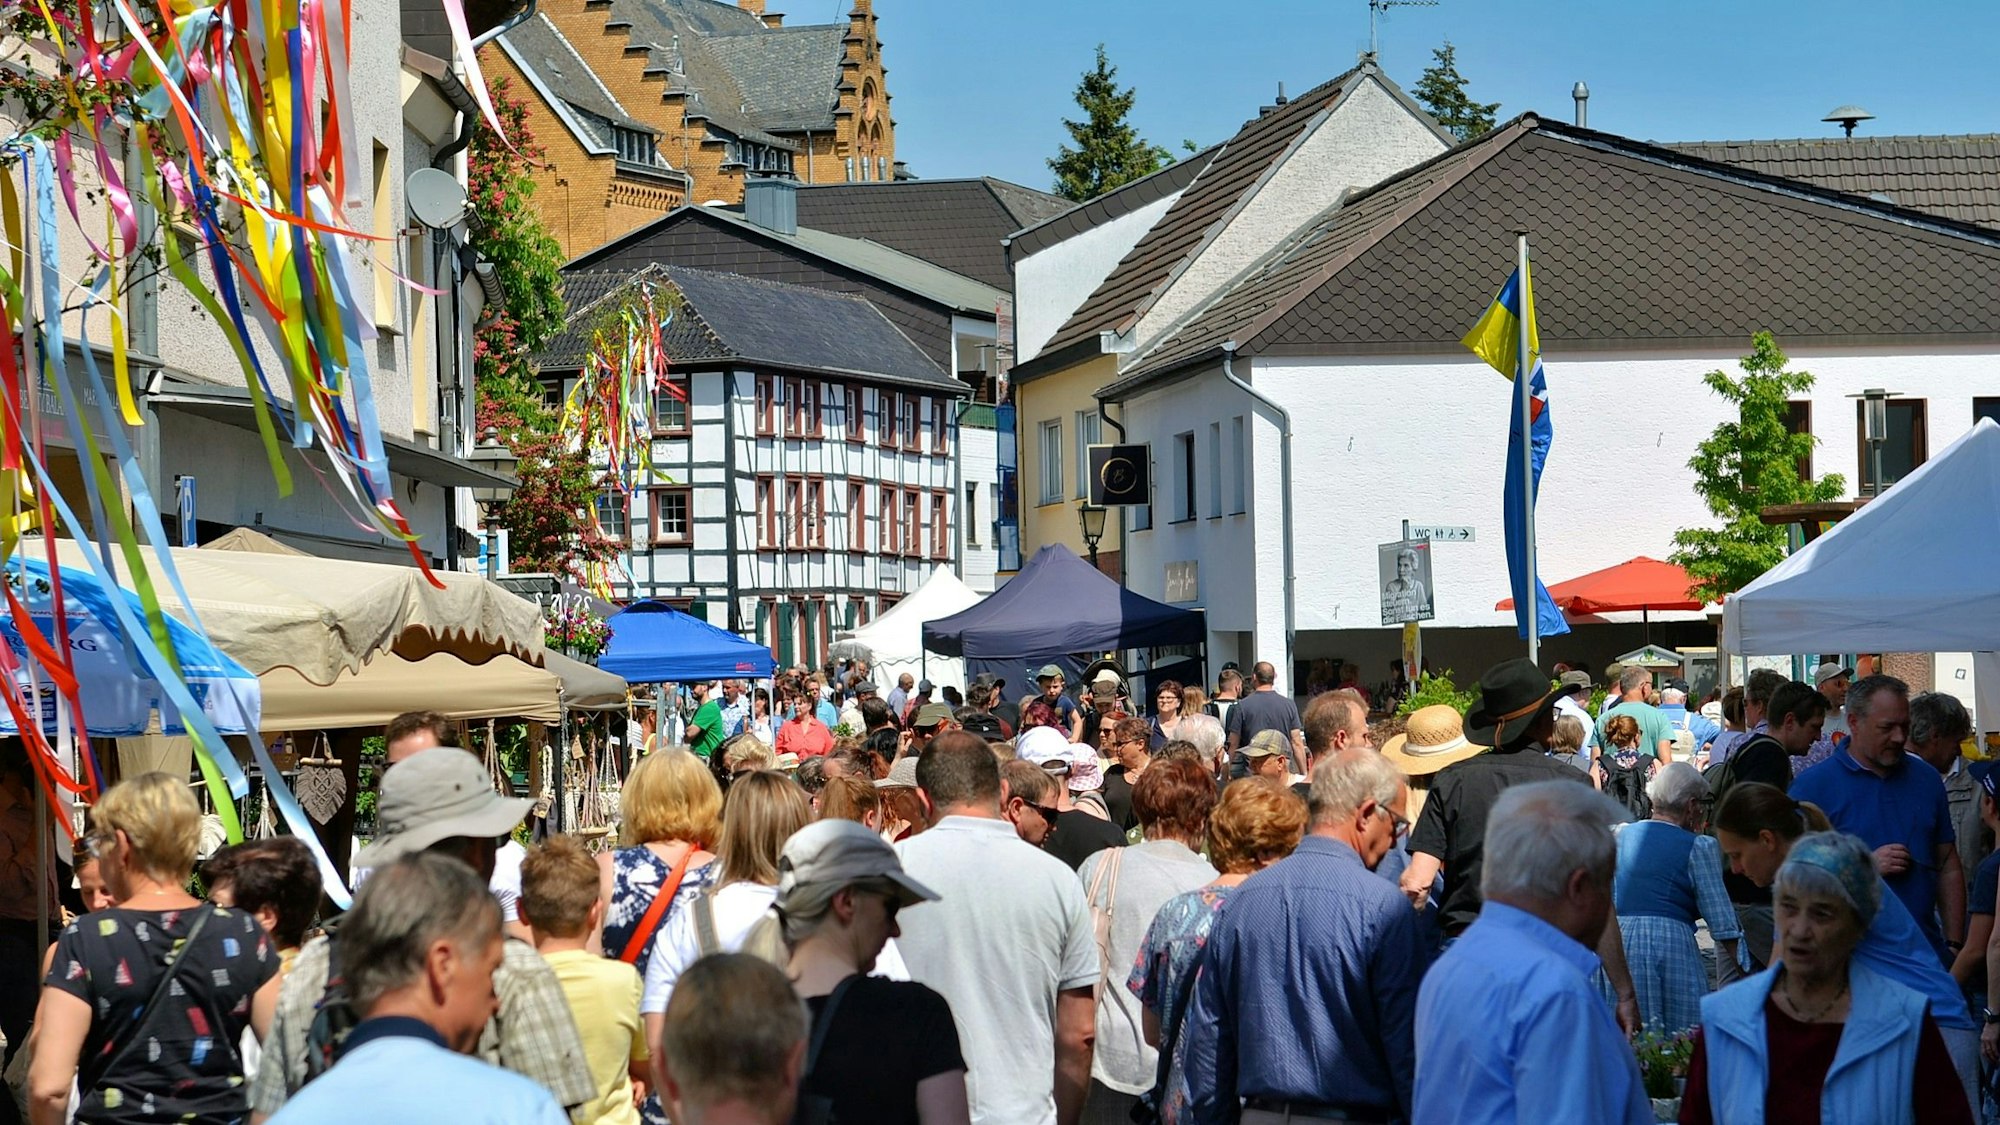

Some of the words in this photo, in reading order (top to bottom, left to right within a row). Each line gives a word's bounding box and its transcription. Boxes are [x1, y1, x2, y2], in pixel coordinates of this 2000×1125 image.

[1414, 528, 1431, 538] WC
[1382, 590, 1417, 600] Migration
[1382, 606, 1404, 616] Sonst
[1405, 604, 1419, 613] tun
[1420, 603, 1431, 611] es
[1382, 615, 1395, 624] die
